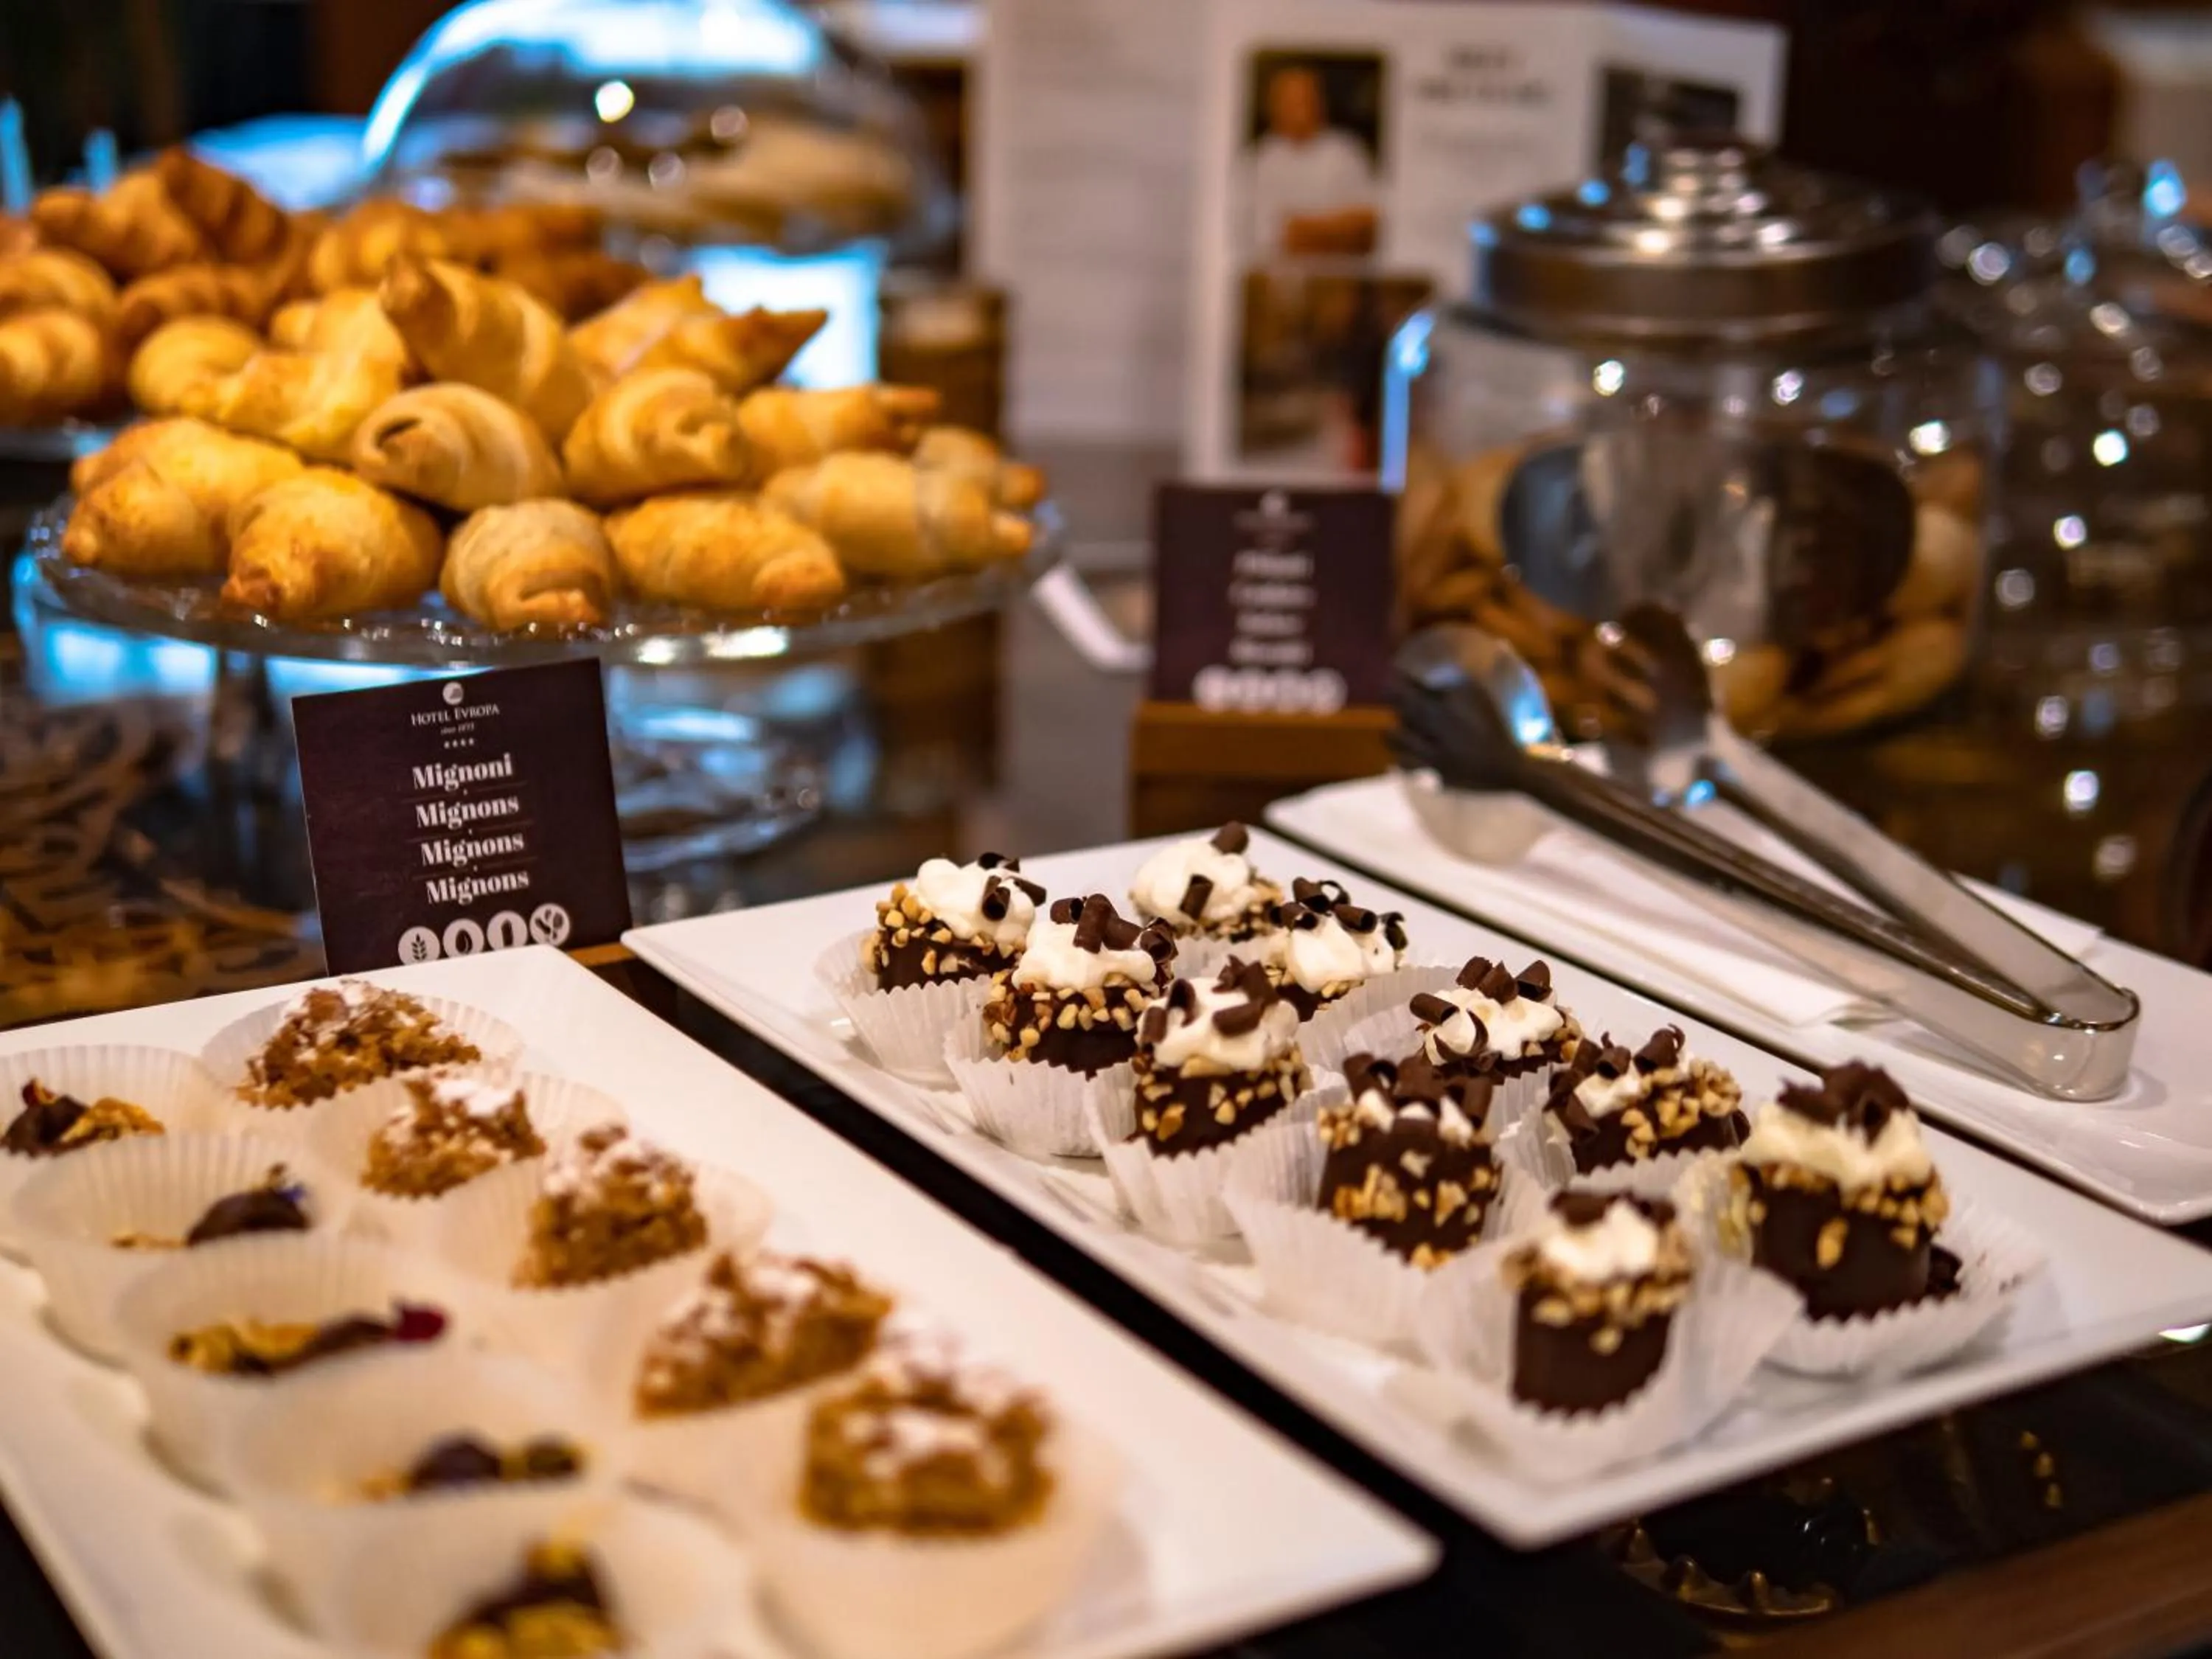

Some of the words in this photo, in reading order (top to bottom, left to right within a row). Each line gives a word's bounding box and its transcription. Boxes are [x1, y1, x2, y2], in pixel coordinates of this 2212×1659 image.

[411, 710, 450, 726] HOTEL
[412, 752, 512, 792] Mignoni
[415, 796, 519, 830] Mignons
[421, 833, 524, 867] Mignons
[426, 871, 529, 905] Mignons
